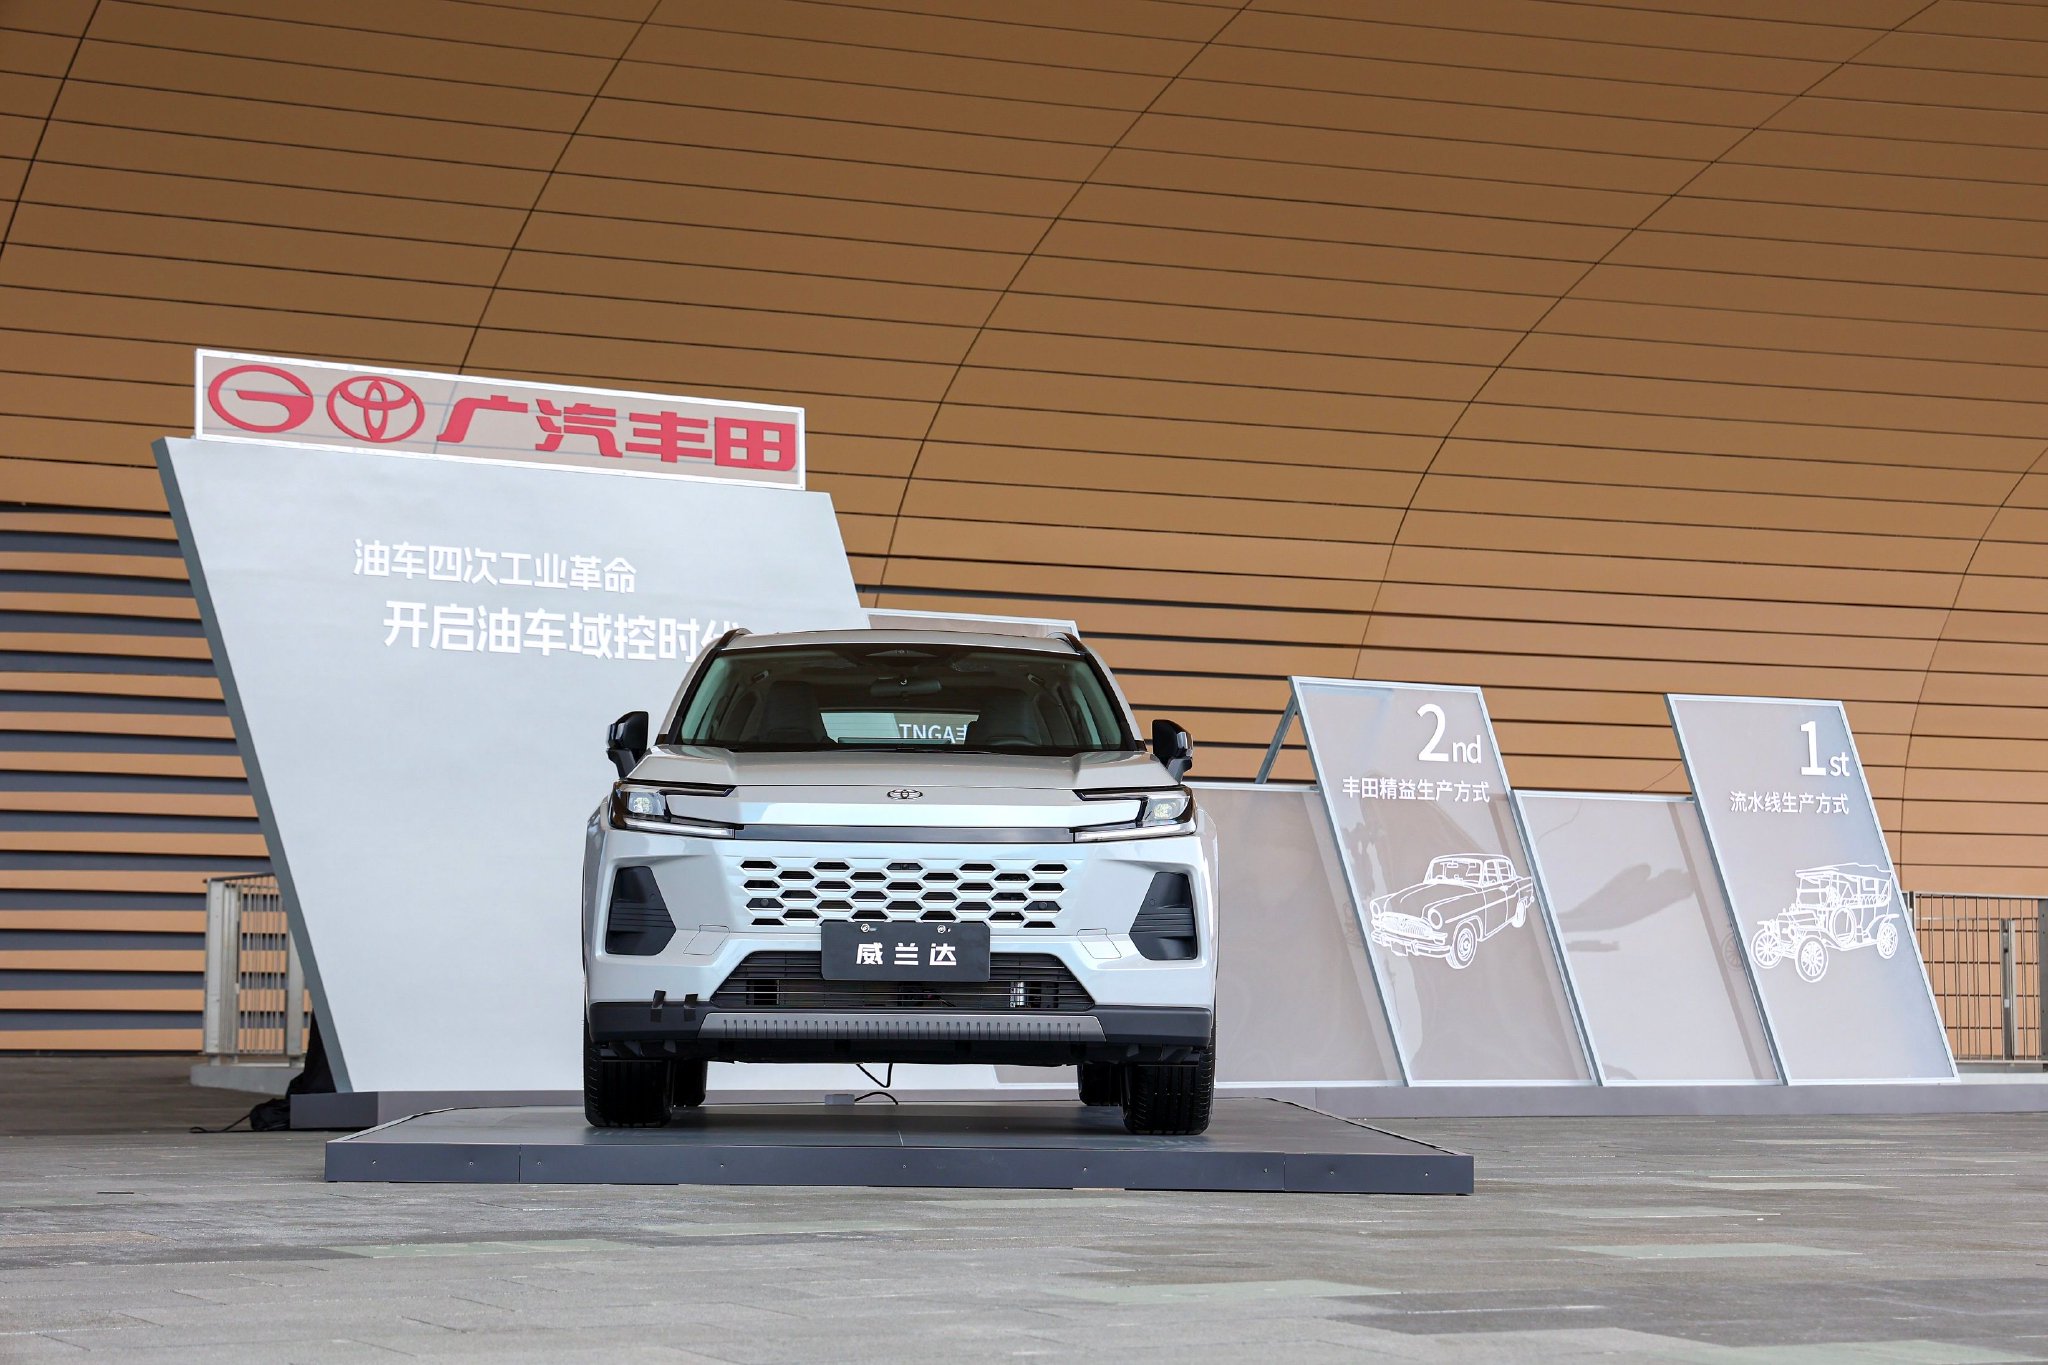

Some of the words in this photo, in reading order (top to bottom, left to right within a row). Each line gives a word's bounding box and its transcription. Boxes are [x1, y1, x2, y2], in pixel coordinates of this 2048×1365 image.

[436, 395, 797, 471] 广汽丰田
[353, 539, 637, 593] 油车四次工业革命
[1416, 703, 1482, 763] 2nd
[1800, 721, 1850, 776] 1st
[1342, 776, 1490, 802] 丰田精益生产方式
[1730, 791, 1850, 814] 流水线生产方式
[856, 942, 957, 966] 威兰达
